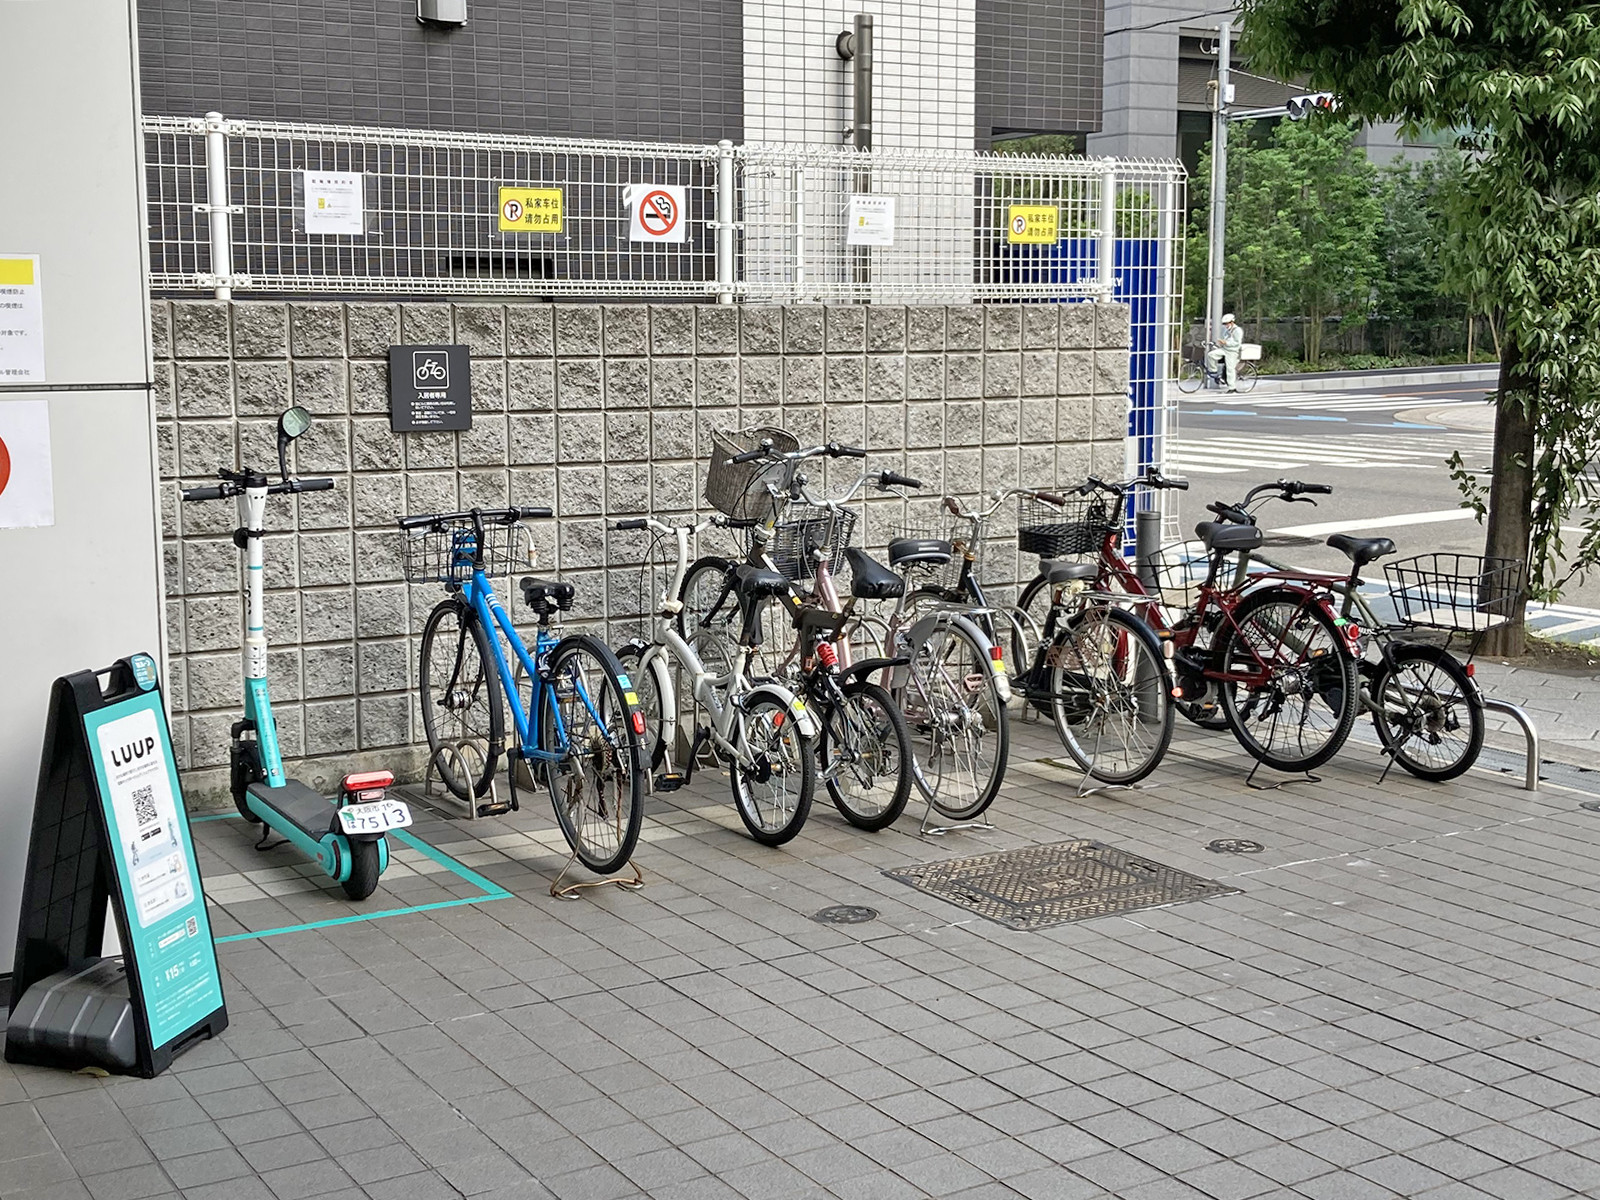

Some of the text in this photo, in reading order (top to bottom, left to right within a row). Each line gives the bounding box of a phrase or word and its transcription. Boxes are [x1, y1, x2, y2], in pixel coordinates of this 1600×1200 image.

[525, 198, 559, 209] 私家车位
[525, 213, 559, 225] 请勿占用
[110, 736, 155, 767] LUUP
[357, 808, 406, 830] 7513
